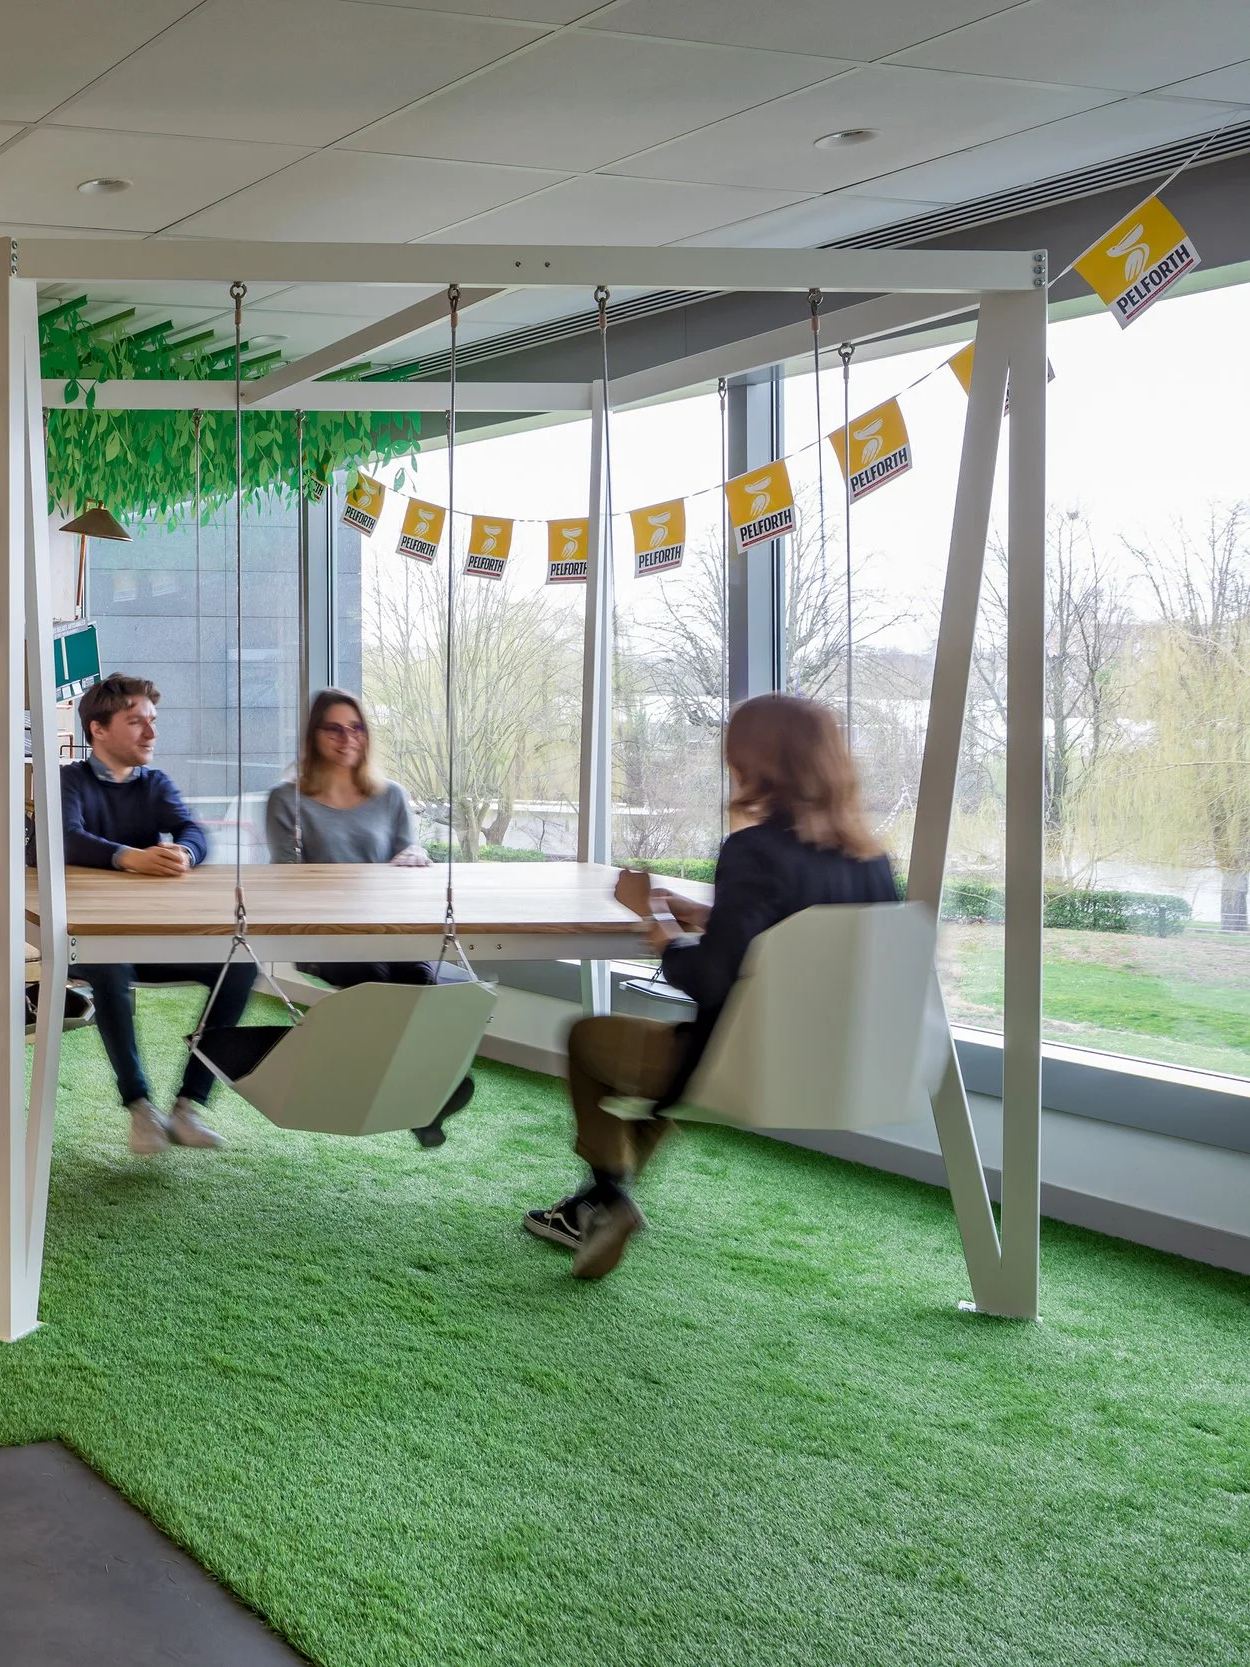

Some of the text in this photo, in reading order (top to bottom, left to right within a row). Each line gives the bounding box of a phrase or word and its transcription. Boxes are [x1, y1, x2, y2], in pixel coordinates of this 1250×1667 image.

[1116, 244, 1190, 315] PELFORTH
[850, 447, 908, 493] PELFORTH
[345, 505, 376, 530] PELFORTH
[740, 508, 792, 542] PELFORTH
[400, 535, 435, 557] PELFORTH
[638, 545, 682, 568] PELFORTH
[468, 555, 504, 573] PELFORTH
